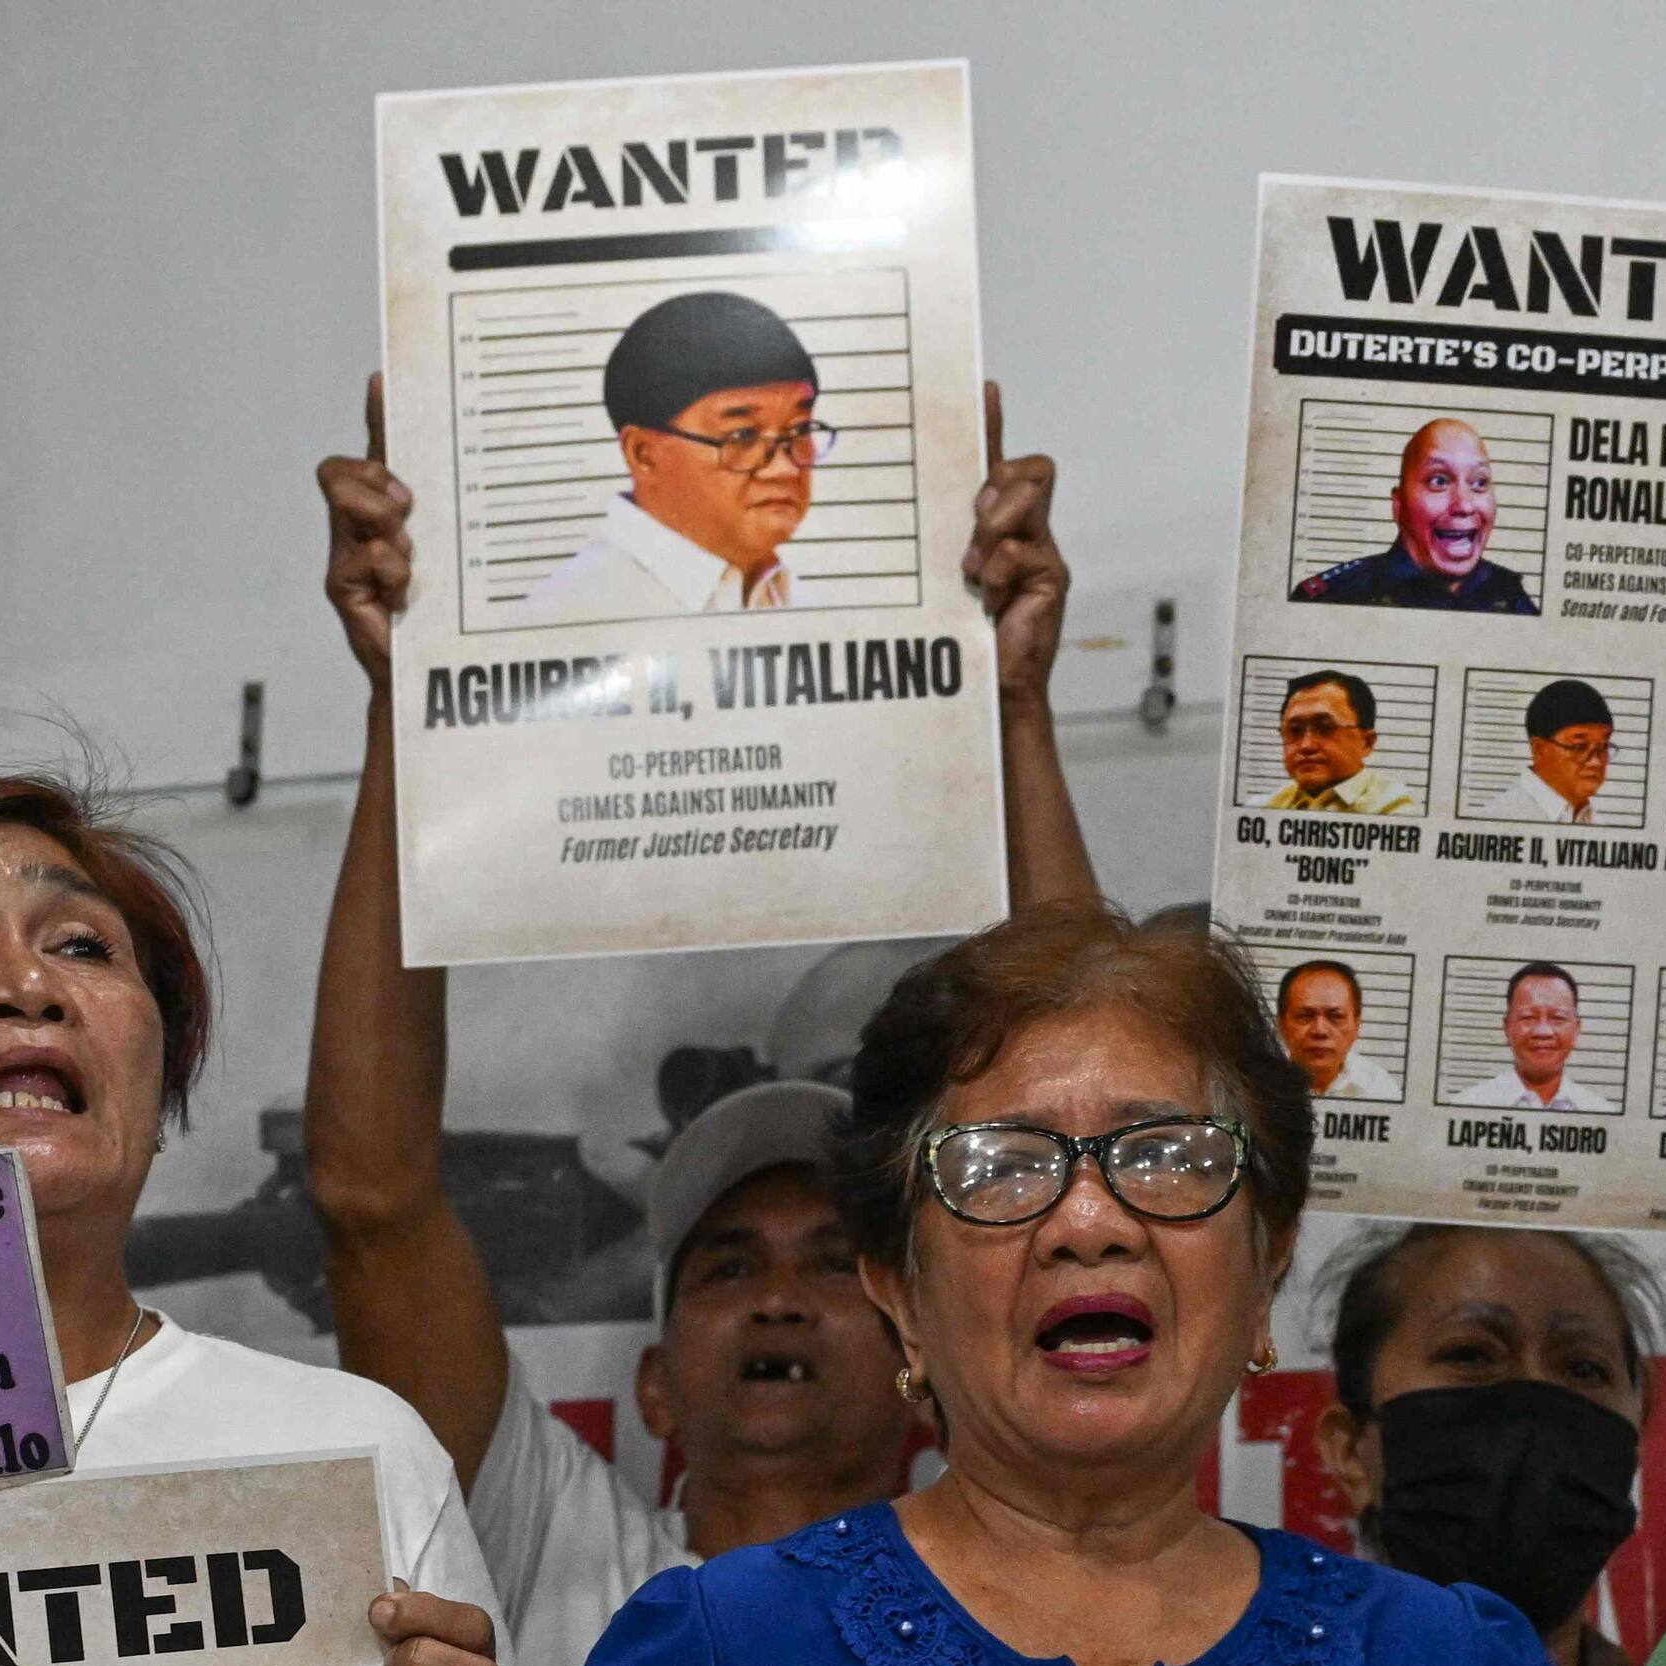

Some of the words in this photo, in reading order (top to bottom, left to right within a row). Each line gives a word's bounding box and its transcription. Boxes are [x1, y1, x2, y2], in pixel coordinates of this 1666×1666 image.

[1569, 418, 1648, 466] DELA
[1563, 571, 1615, 591] CRIMES
[1560, 599, 1617, 619] Senator
[1620, 603, 1646, 621] and
[709, 636, 962, 711] VITALIANO
[610, 744, 781, 779] CO-PERPETRATOR
[559, 793, 635, 822] CRIMES
[642, 788, 724, 817] AGAINST
[732, 781, 836, 812] HUMANITY
[562, 837, 640, 863] Former
[643, 830, 725, 858] Justice
[730, 823, 838, 853] Secretary
[1237, 816, 1270, 847] GO,
[1279, 819, 1420, 853] CHRISTOPHER
[1437, 832, 1524, 863] AGUIRRE
[1530, 838, 1548, 867] II,
[1556, 839, 1657, 870] VITALIANO
[1324, 1113, 1389, 1142] DANTE
[1447, 1116, 1532, 1155] LAPEÑA,
[1540, 1125, 1606, 1153] ISIDRO
